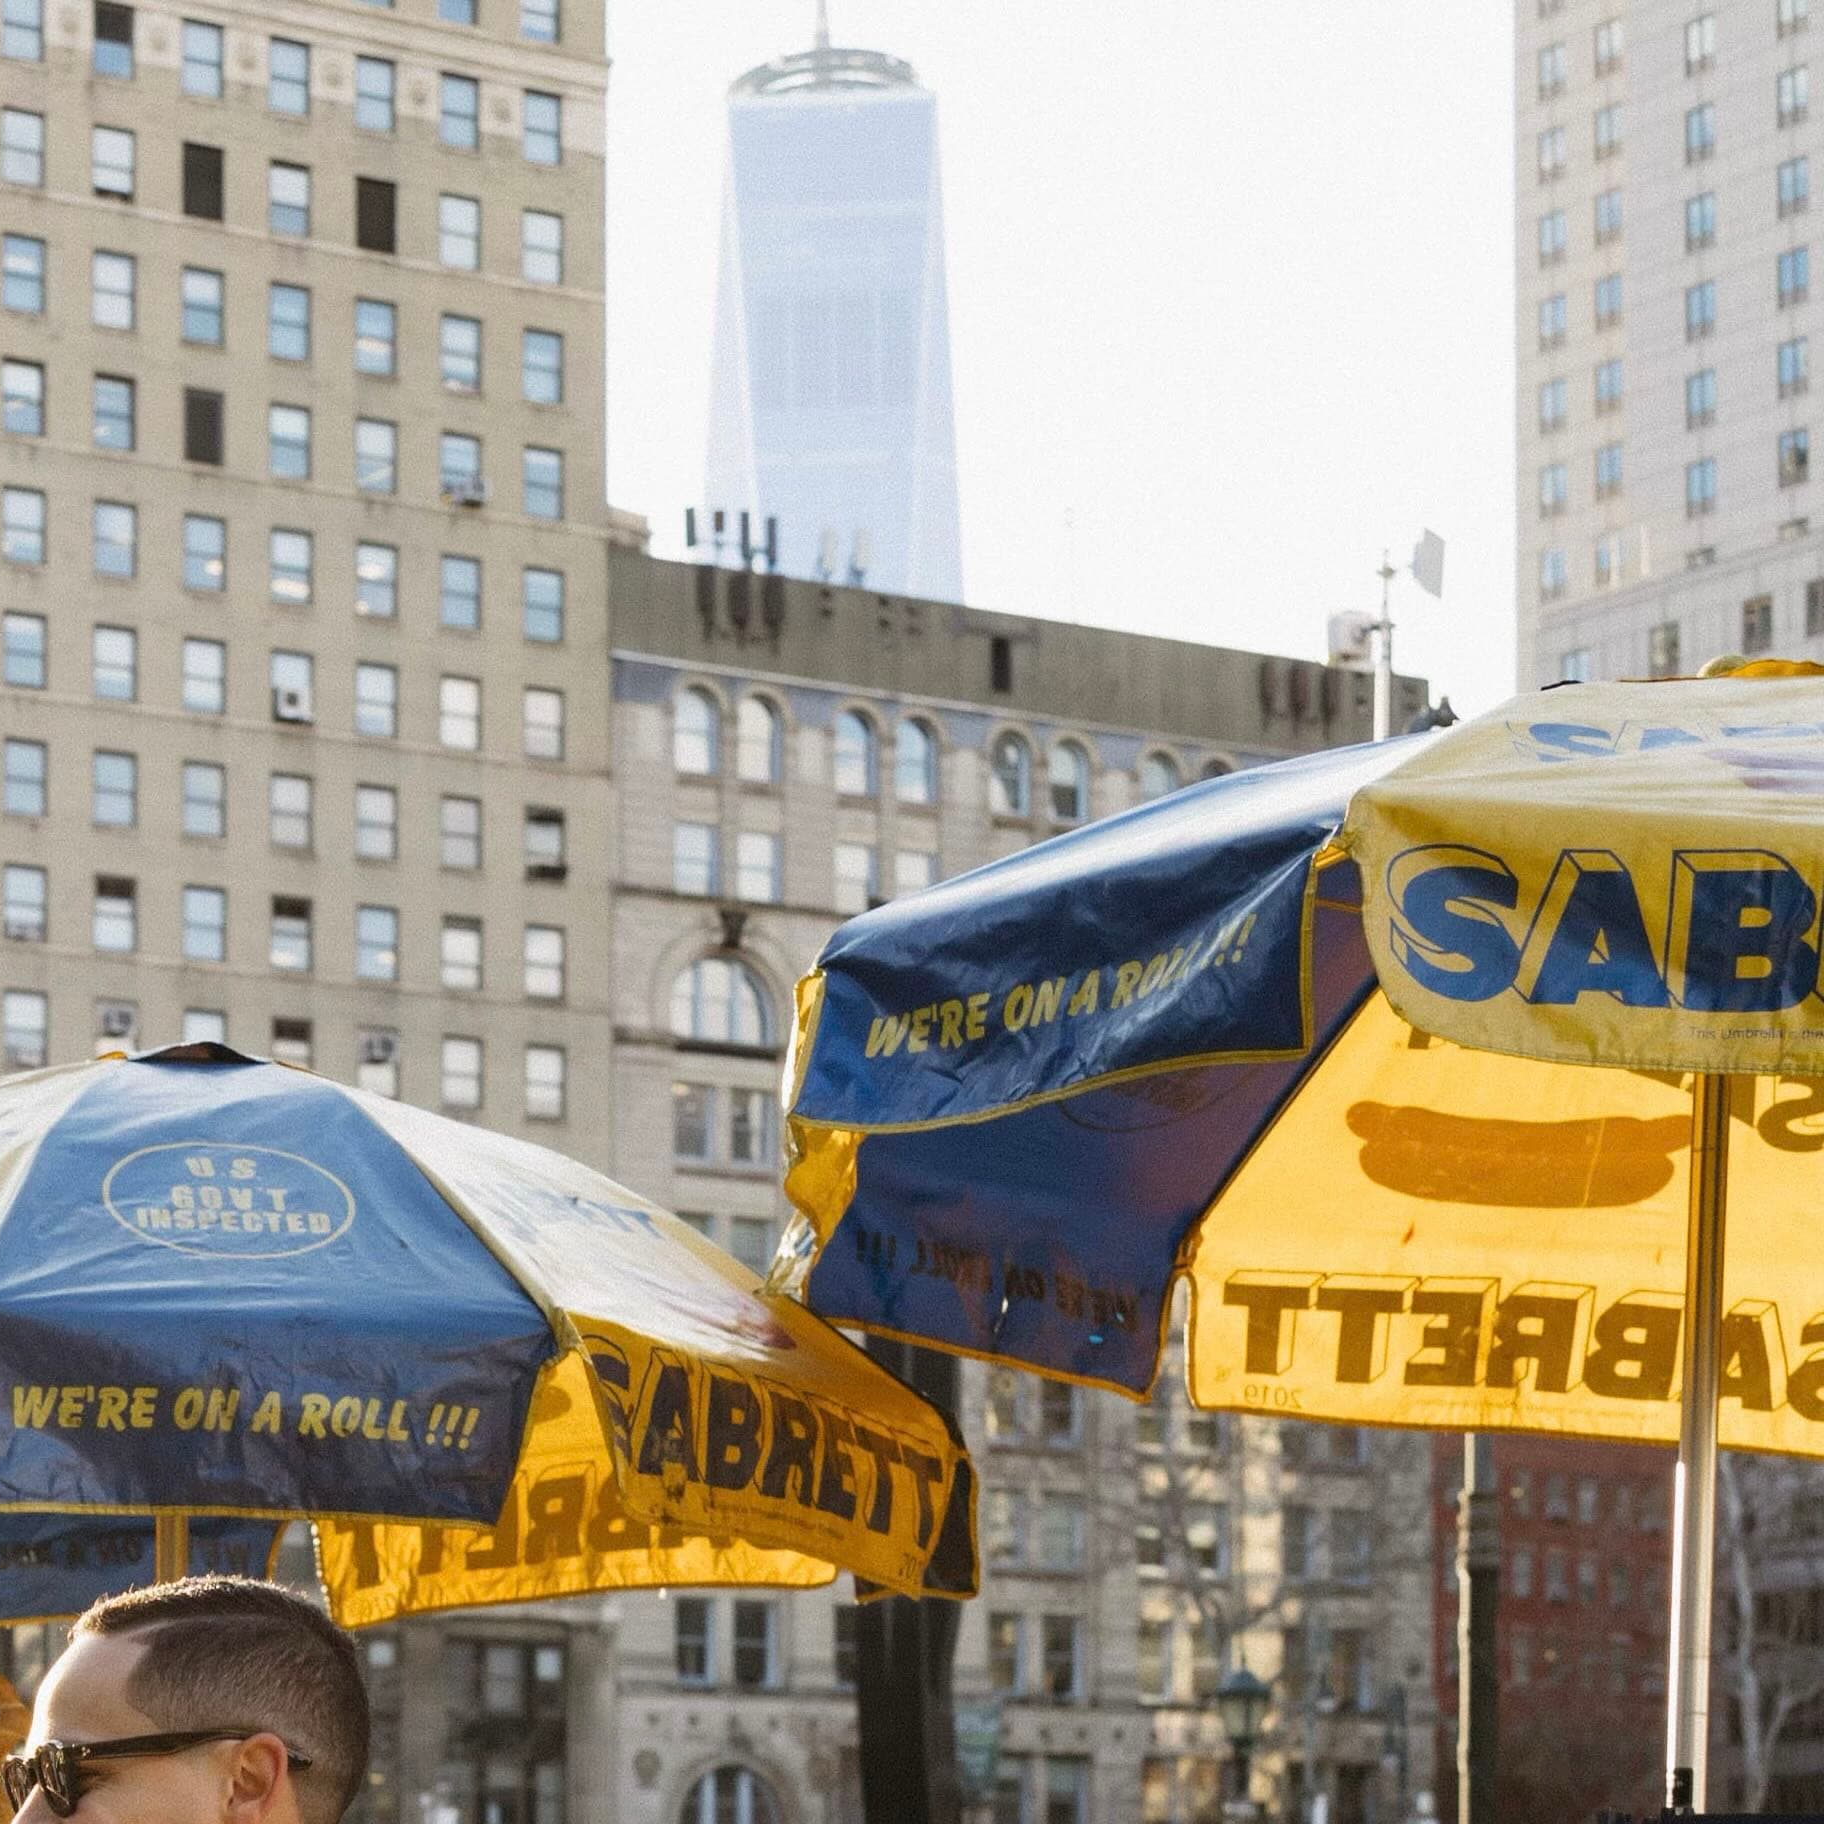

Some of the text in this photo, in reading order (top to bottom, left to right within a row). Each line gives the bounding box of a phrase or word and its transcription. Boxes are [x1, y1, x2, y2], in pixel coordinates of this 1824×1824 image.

[1386, 842, 1824, 1013] SAB
[864, 992, 990, 1058] WE'RE
[1003, 976, 1066, 1032] ON
[1067, 969, 1101, 1016] A
[136, 1207, 332, 1234] INSPECTED
[170, 1184, 289, 1212] GOV'T
[12, 1385, 481, 1452] WE'RE ON A ROLL !!!
